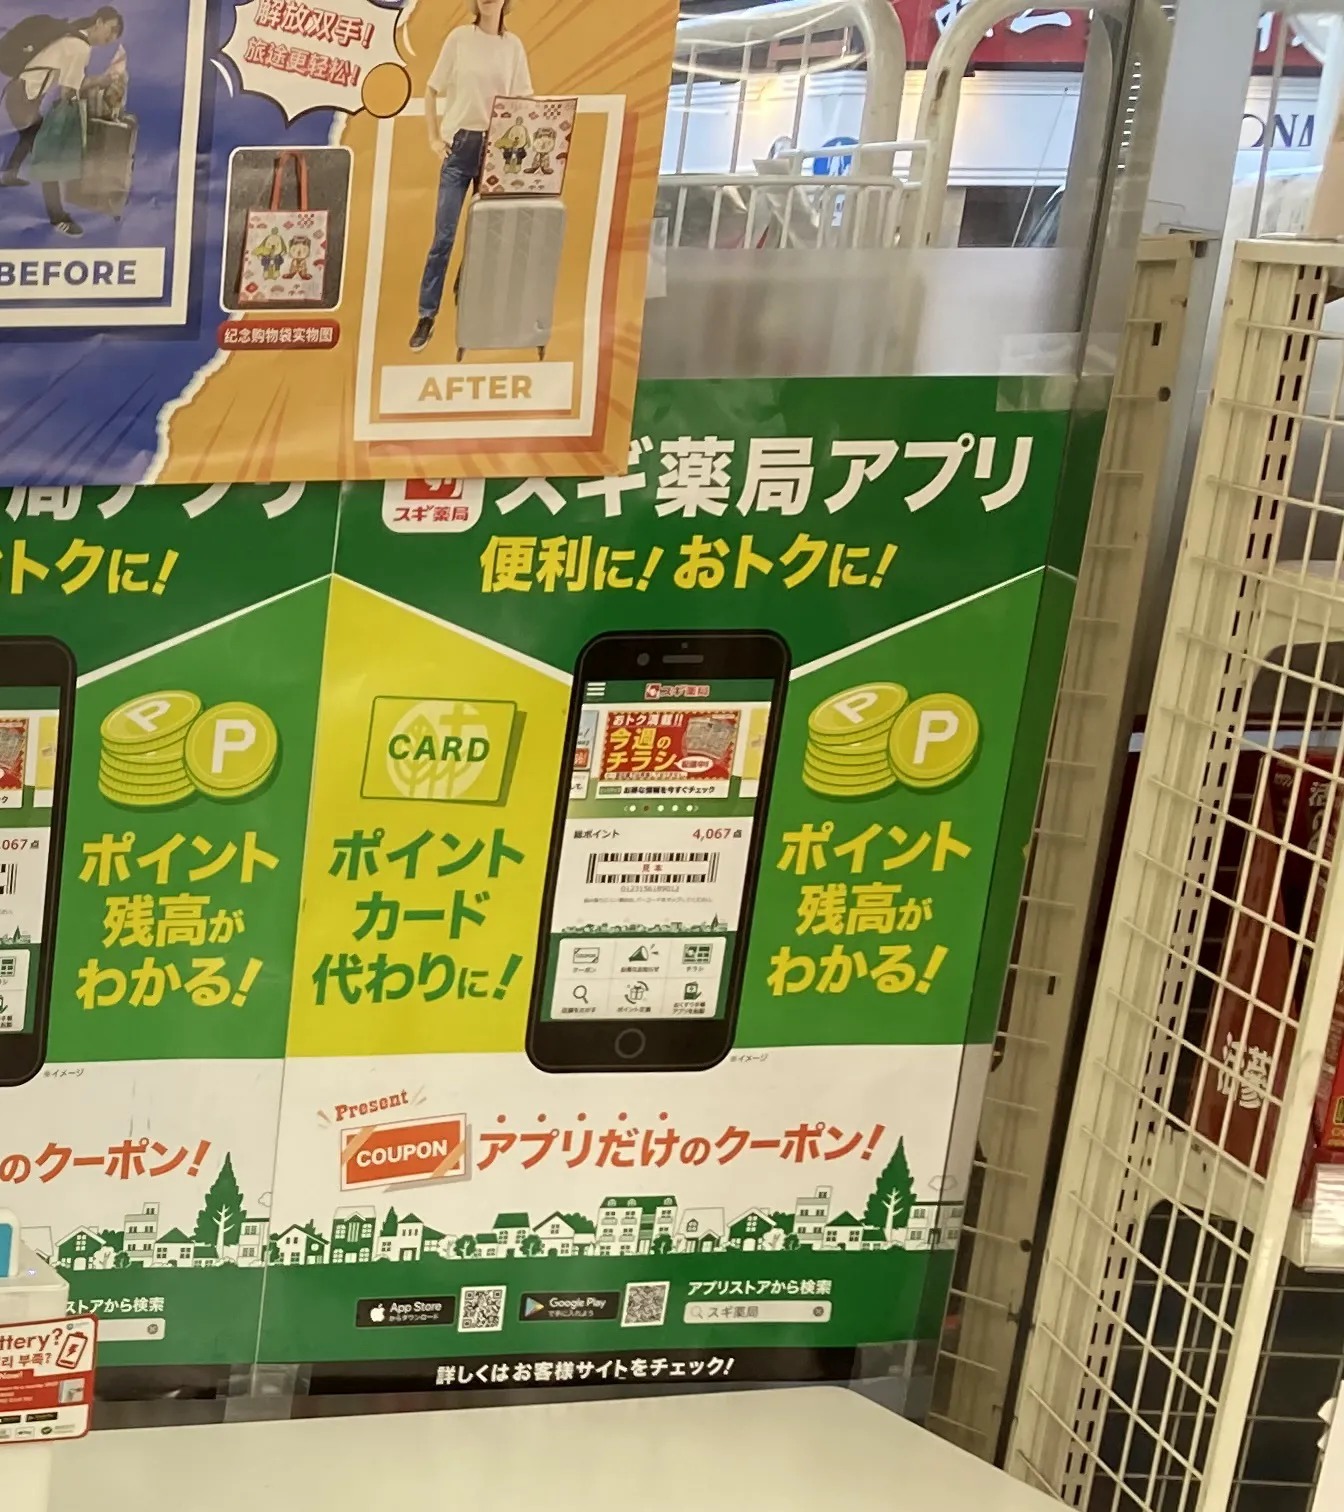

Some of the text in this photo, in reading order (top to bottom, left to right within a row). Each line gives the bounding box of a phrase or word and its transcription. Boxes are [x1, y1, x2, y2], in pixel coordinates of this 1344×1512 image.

[244, 37, 361, 88] 旅途更轻松!
[224, 327, 333, 345] 纪念购物袋实物图
[418, 375, 533, 402] AFTER
[393, 505, 470, 523] スギ薬局
[480, 533, 898, 593] 便利に! おトクに!
[212, 719, 256, 773] P
[389, 737, 490, 763] CARD
[607, 751, 677, 771] チラシ
[610, 728, 671, 750] 今週の
[913, 710, 960, 764] P
[79, 831, 279, 886] ポイント
[328, 828, 525, 881] ポイント
[777, 821, 972, 872] ポイント
[102, 893, 245, 948] 残高が
[354, 890, 492, 942] カード
[795, 884, 933, 935] 残高が
[76, 957, 263, 1009] わかる!
[311, 950, 523, 1006] 代わりに!
[767, 945, 949, 996] わかる!
[334, 1089, 409, 1122] Present
[355, 1138, 448, 1167] COUPON
[476, 1122, 885, 1173] アプリだけのクーポン!
[389, 1300, 442, 1315] App Store
[549, 1297, 607, 1311] Google Play
[688, 1279, 832, 1297] アプリストアから検索
[708, 1304, 758, 1319] スギ薬局
[435, 1357, 736, 1386] 詳しくはお客様サイトをチェック!
